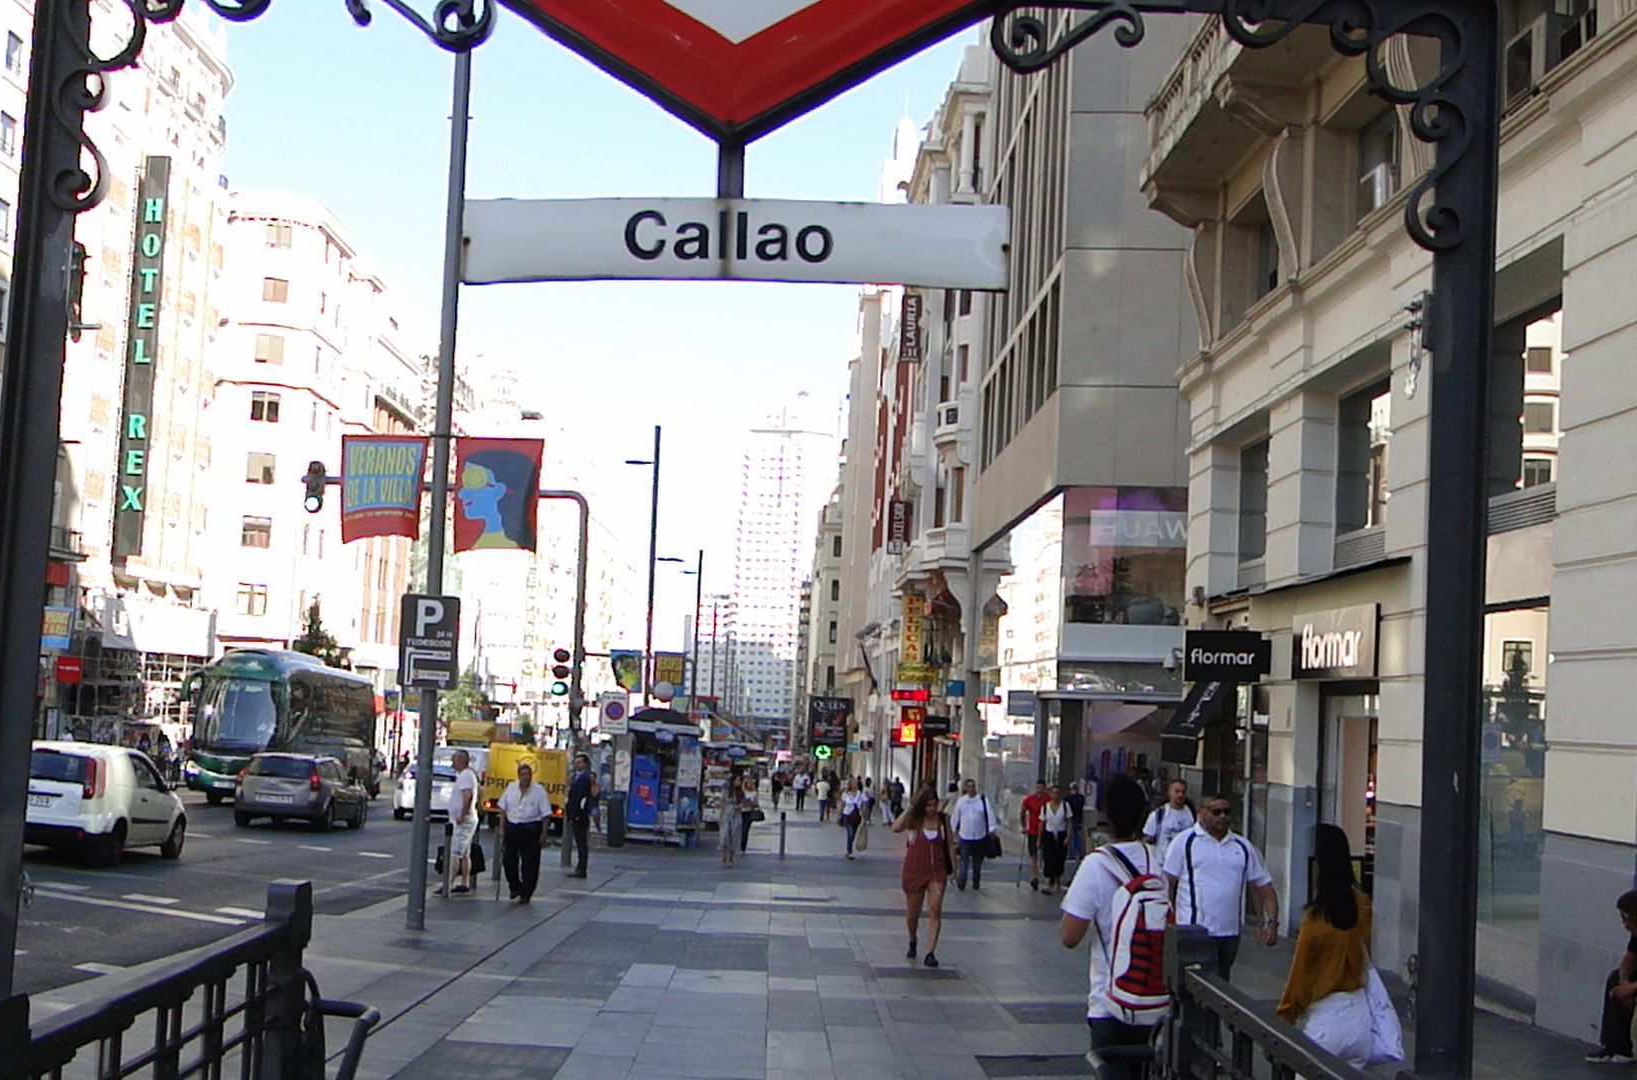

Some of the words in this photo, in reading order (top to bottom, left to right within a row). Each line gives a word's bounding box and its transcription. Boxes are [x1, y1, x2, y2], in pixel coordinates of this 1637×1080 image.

[625, 209, 834, 263] Callao
[134, 197, 164, 364] HOTEL
[120, 414, 147, 513] REX
[350, 445, 417, 476] VERANOS
[380, 478, 413, 504] VILLA
[416, 599, 444, 637] P
[905, 597, 922, 661] PELUCAS
[1191, 648, 1255, 665] flormar
[1298, 623, 1363, 669] flormar
